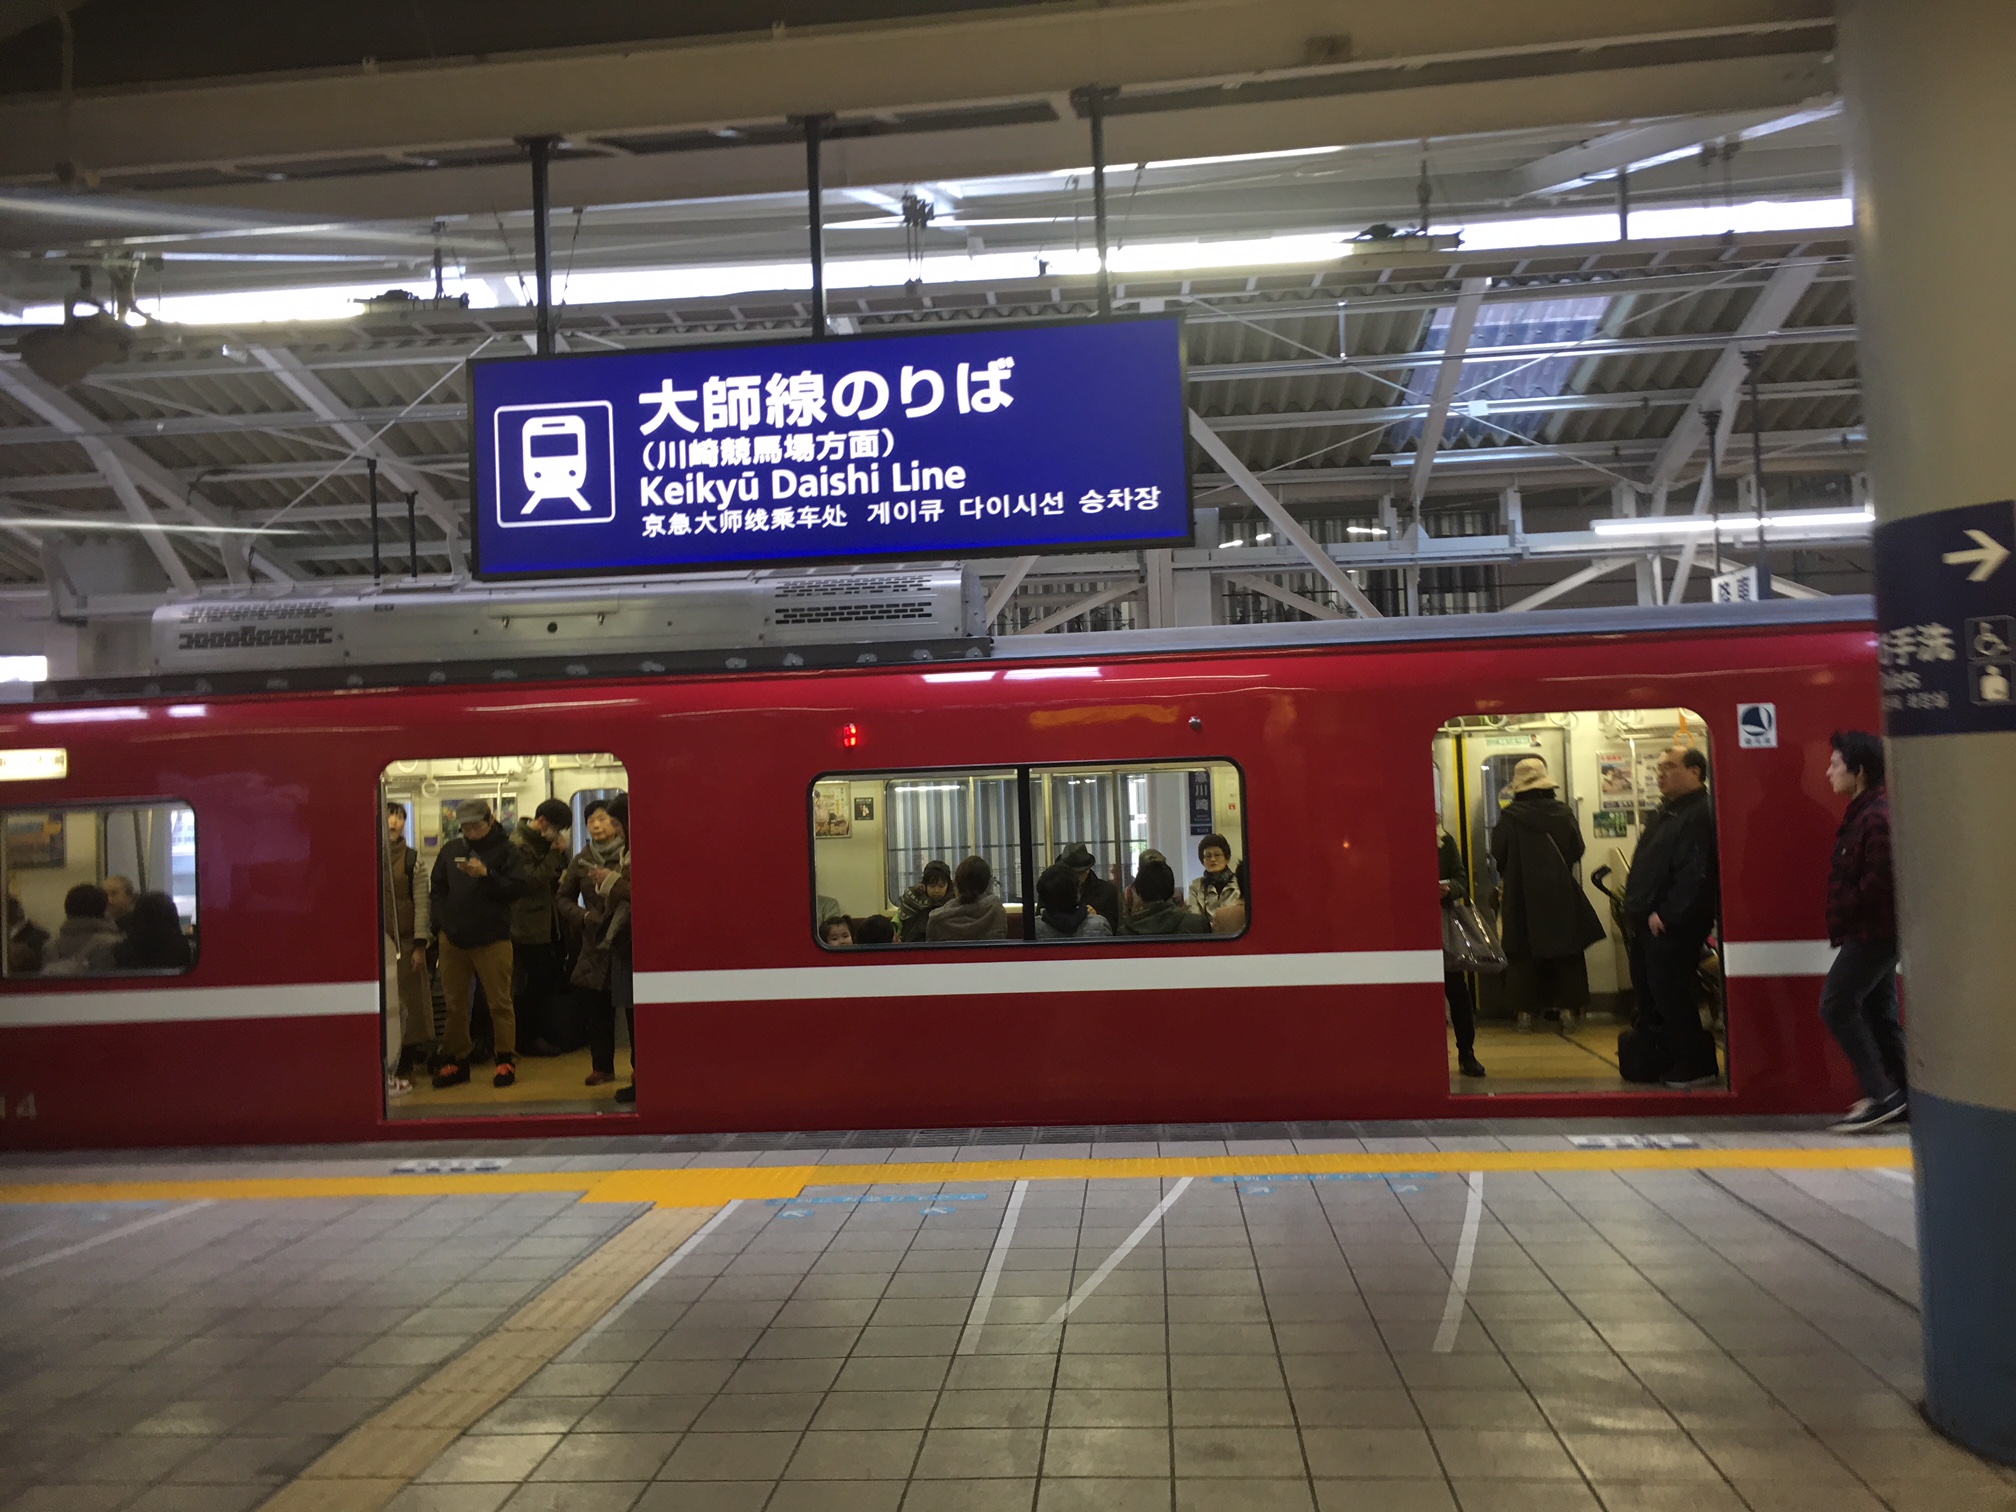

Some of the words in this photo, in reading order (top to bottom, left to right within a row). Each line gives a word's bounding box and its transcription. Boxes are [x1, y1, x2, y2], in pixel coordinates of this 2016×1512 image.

[638, 356, 1016, 437] 大師線のりば
[640, 470, 760, 511] Keikyū
[771, 462, 880, 500] Daishi
[891, 459, 967, 493] Line
[867, 499, 945, 525] 게이큐
[959, 490, 1065, 520] 다이시선
[1078, 485, 1162, 514] 승차장
[641, 503, 848, 538] 京急大师线乘车处
